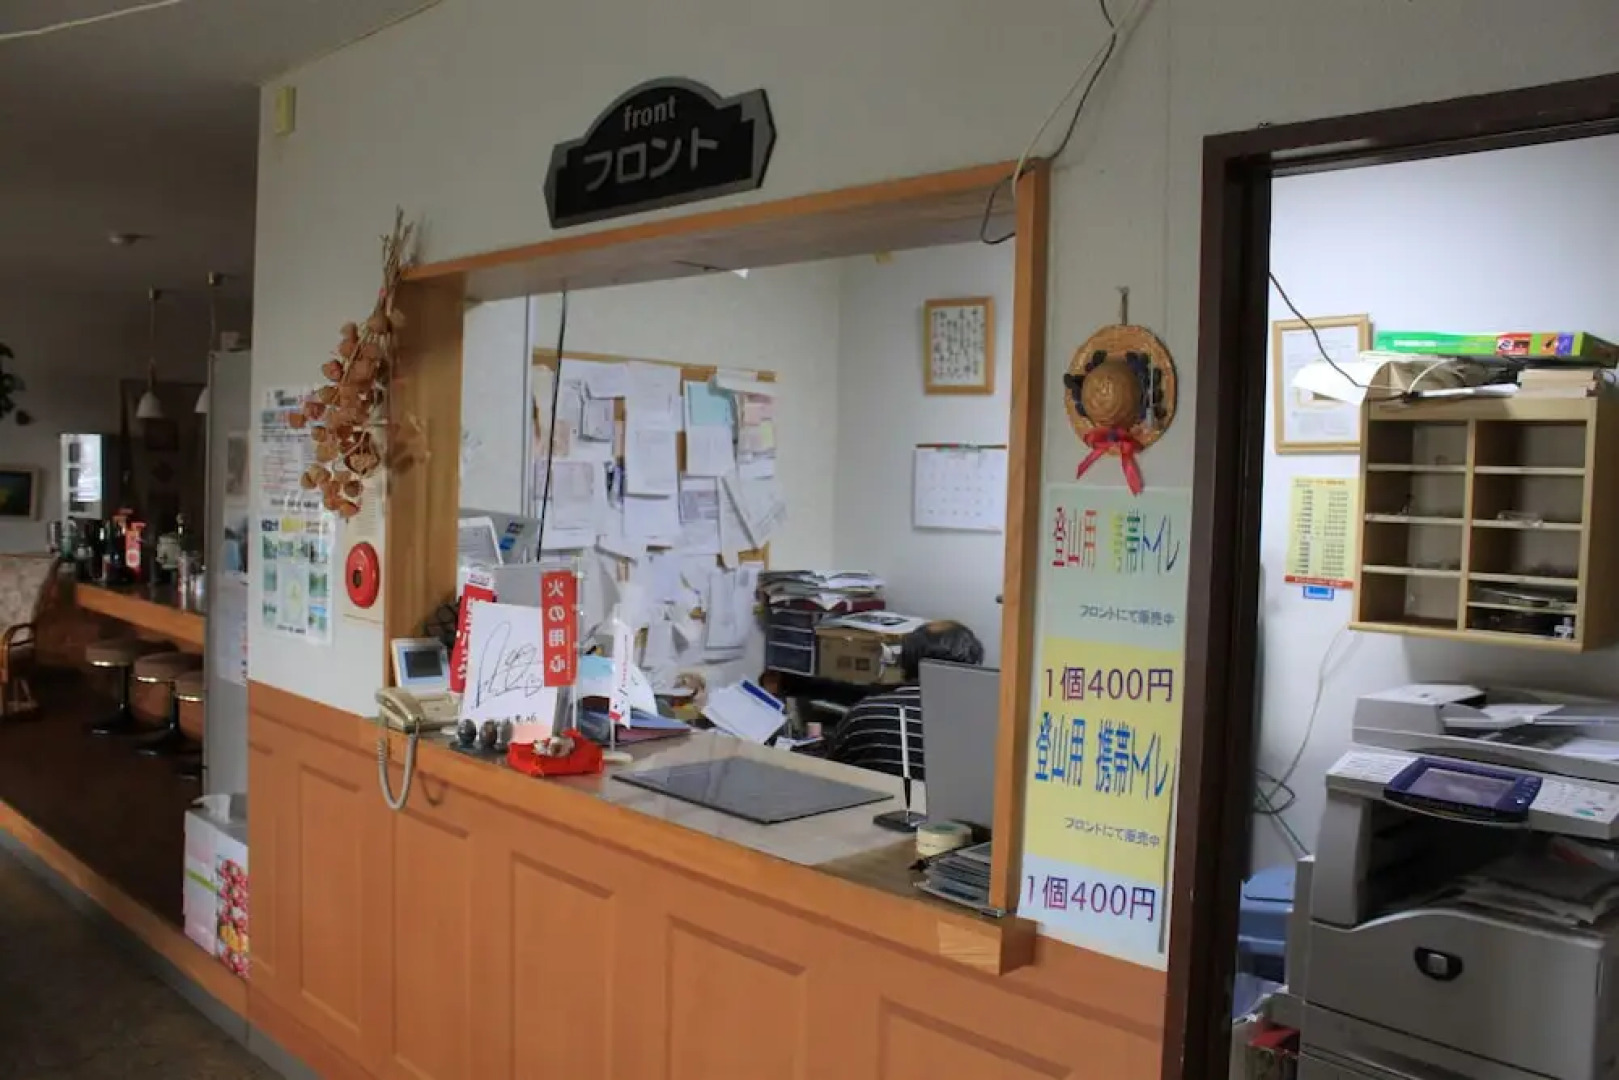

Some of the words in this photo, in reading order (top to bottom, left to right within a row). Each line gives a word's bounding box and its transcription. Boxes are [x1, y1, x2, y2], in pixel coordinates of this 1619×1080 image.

[623, 96, 676, 132] front
[583, 126, 720, 191] フロント
[548, 578, 566, 674] 火の用心
[1079, 604, 1175, 627] フロントにて販売中
[1064, 816, 1160, 848] フロントにて販売中
